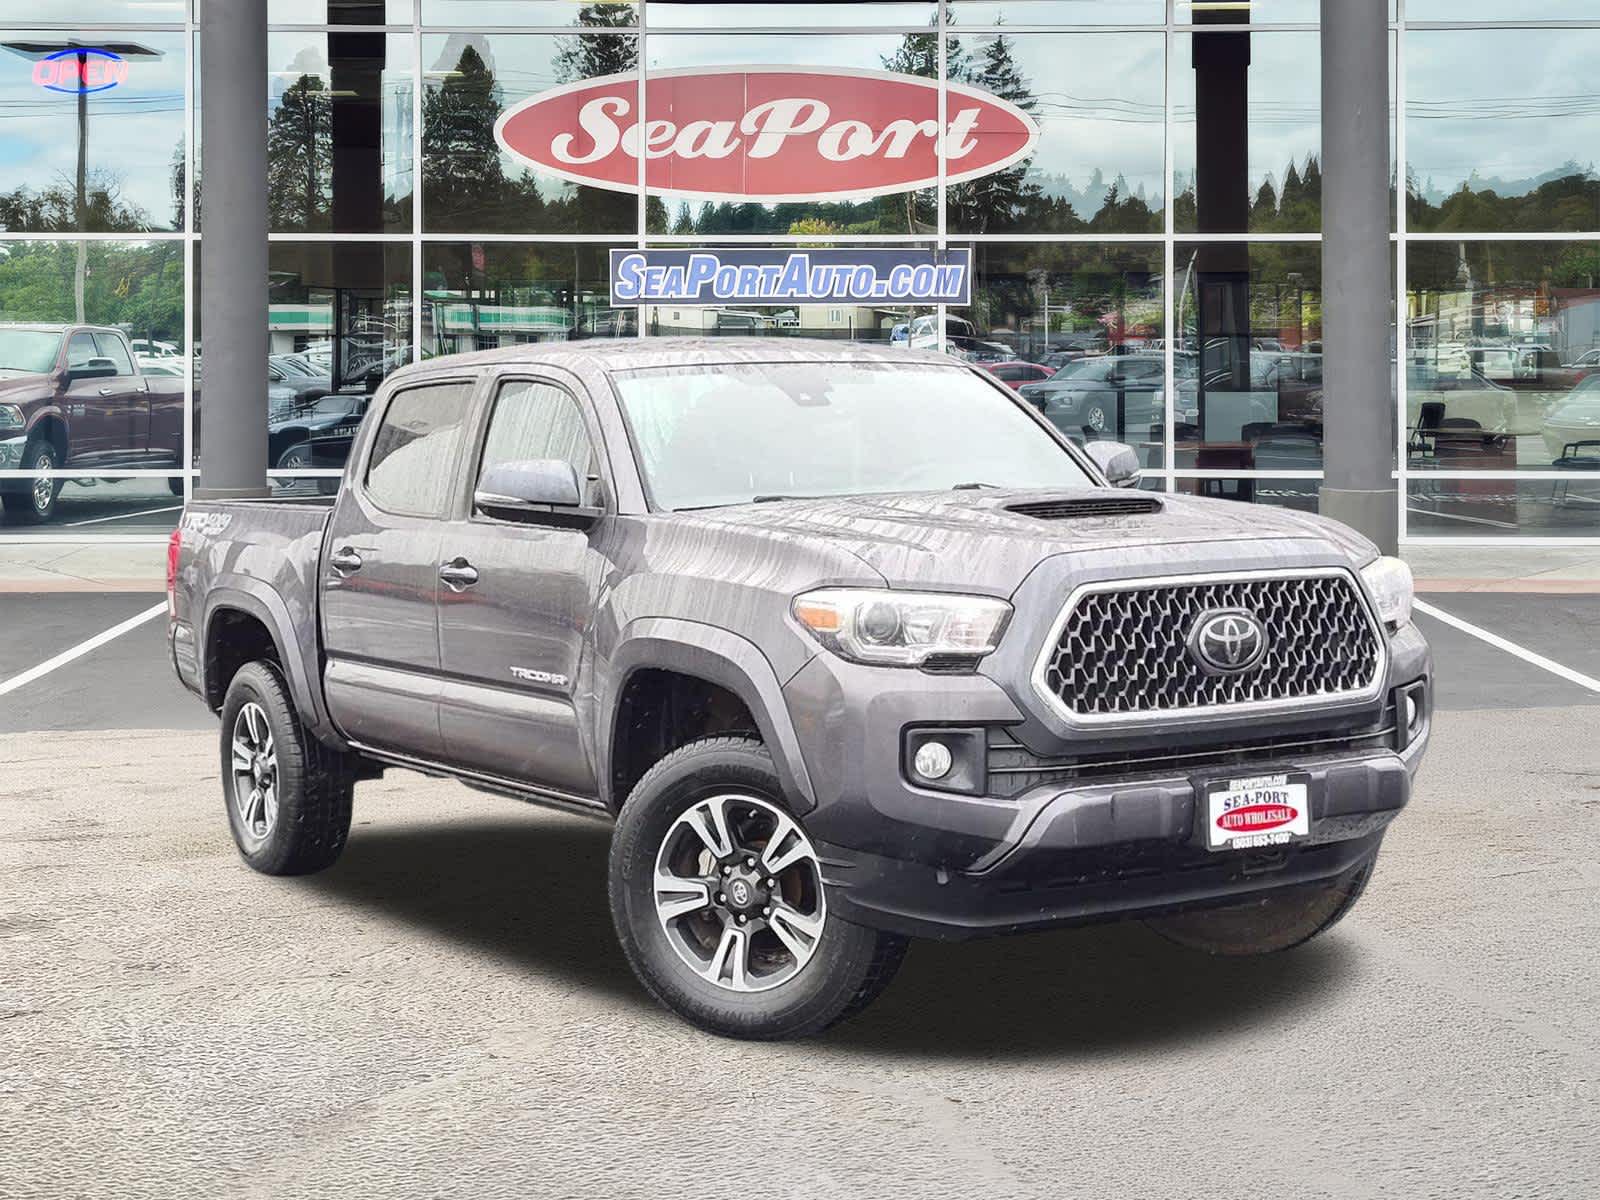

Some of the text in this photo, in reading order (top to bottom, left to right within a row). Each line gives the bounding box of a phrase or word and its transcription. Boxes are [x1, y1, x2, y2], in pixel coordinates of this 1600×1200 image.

[32, 60, 128, 85] OPEN
[551, 97, 982, 165] SeaPort
[1223, 791, 1289, 811] SEA-PORT
[1222, 808, 1292, 828] AUTO WHOLESALE
